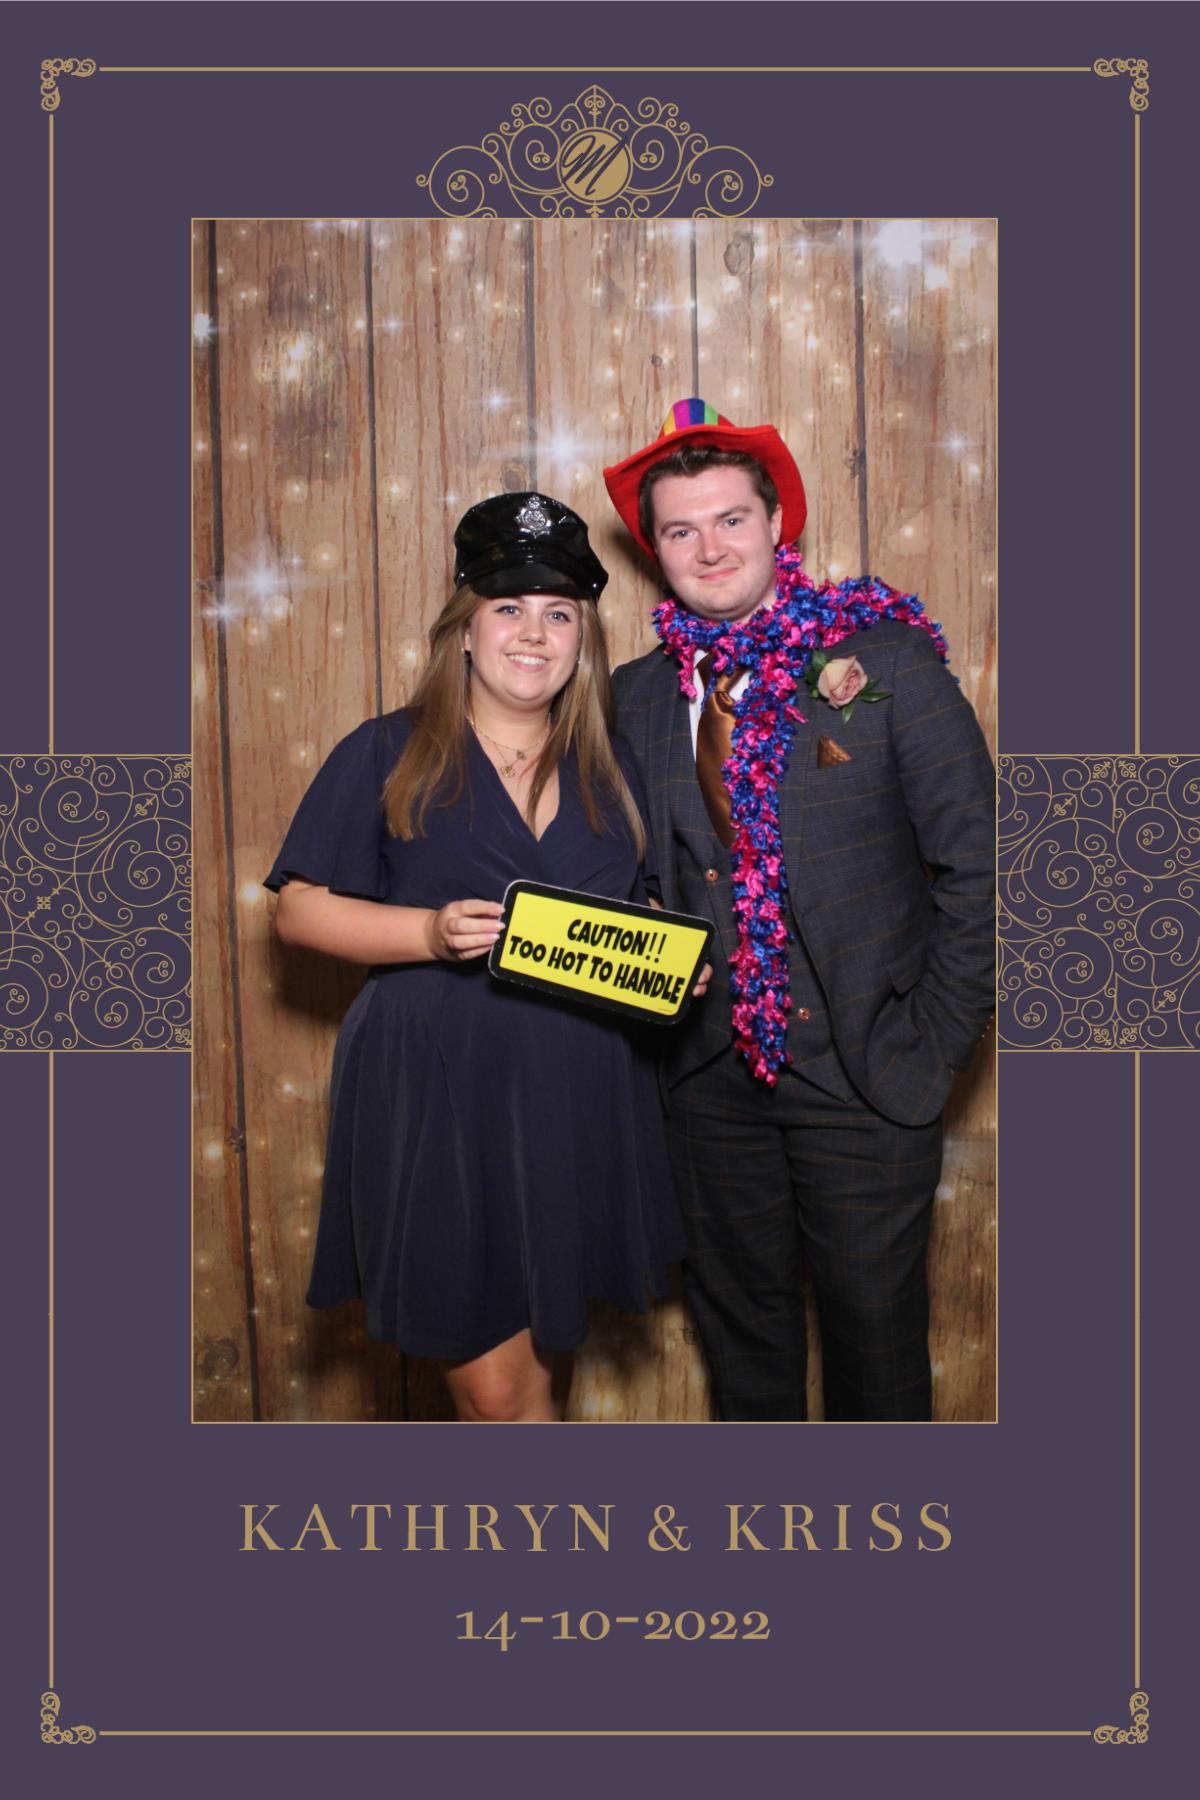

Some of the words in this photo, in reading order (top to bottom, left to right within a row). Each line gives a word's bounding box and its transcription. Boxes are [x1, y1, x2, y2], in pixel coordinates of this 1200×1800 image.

[567, 919, 668, 963] CAUTION!!
[508, 935, 546, 963] TOO
[547, 946, 588, 975] HOT
[588, 956, 614, 982] TO
[613, 964, 686, 1004] HANDLE
